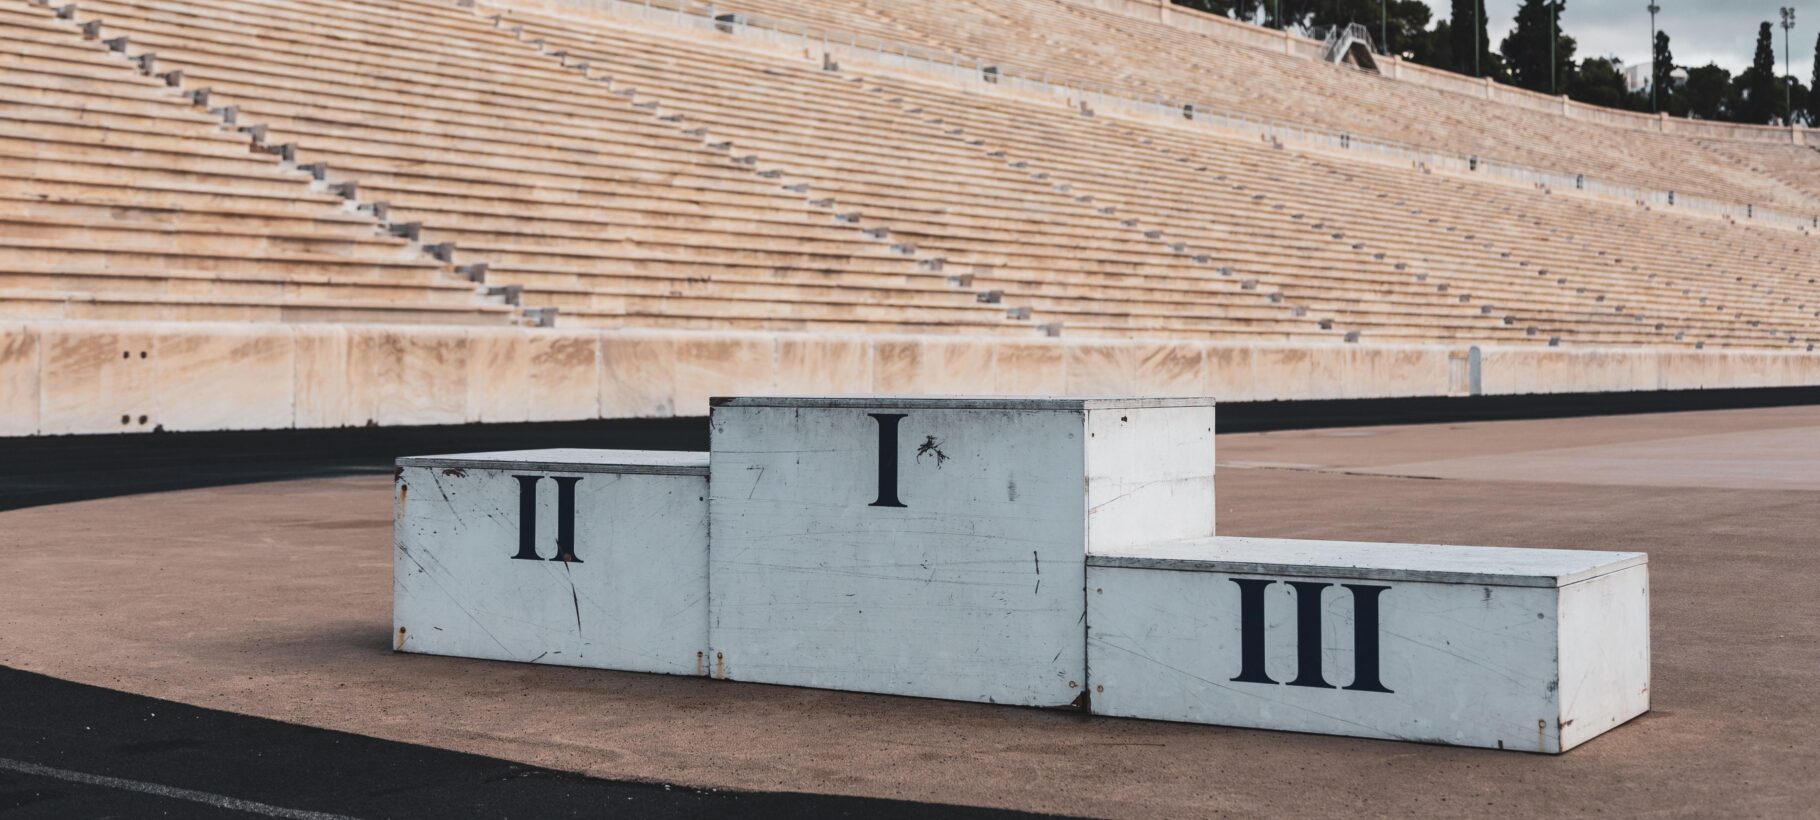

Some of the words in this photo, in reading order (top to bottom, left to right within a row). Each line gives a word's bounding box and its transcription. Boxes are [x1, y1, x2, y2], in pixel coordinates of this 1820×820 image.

[867, 413, 908, 507] I
[511, 475, 584, 563] II
[1229, 578, 1394, 693] III
